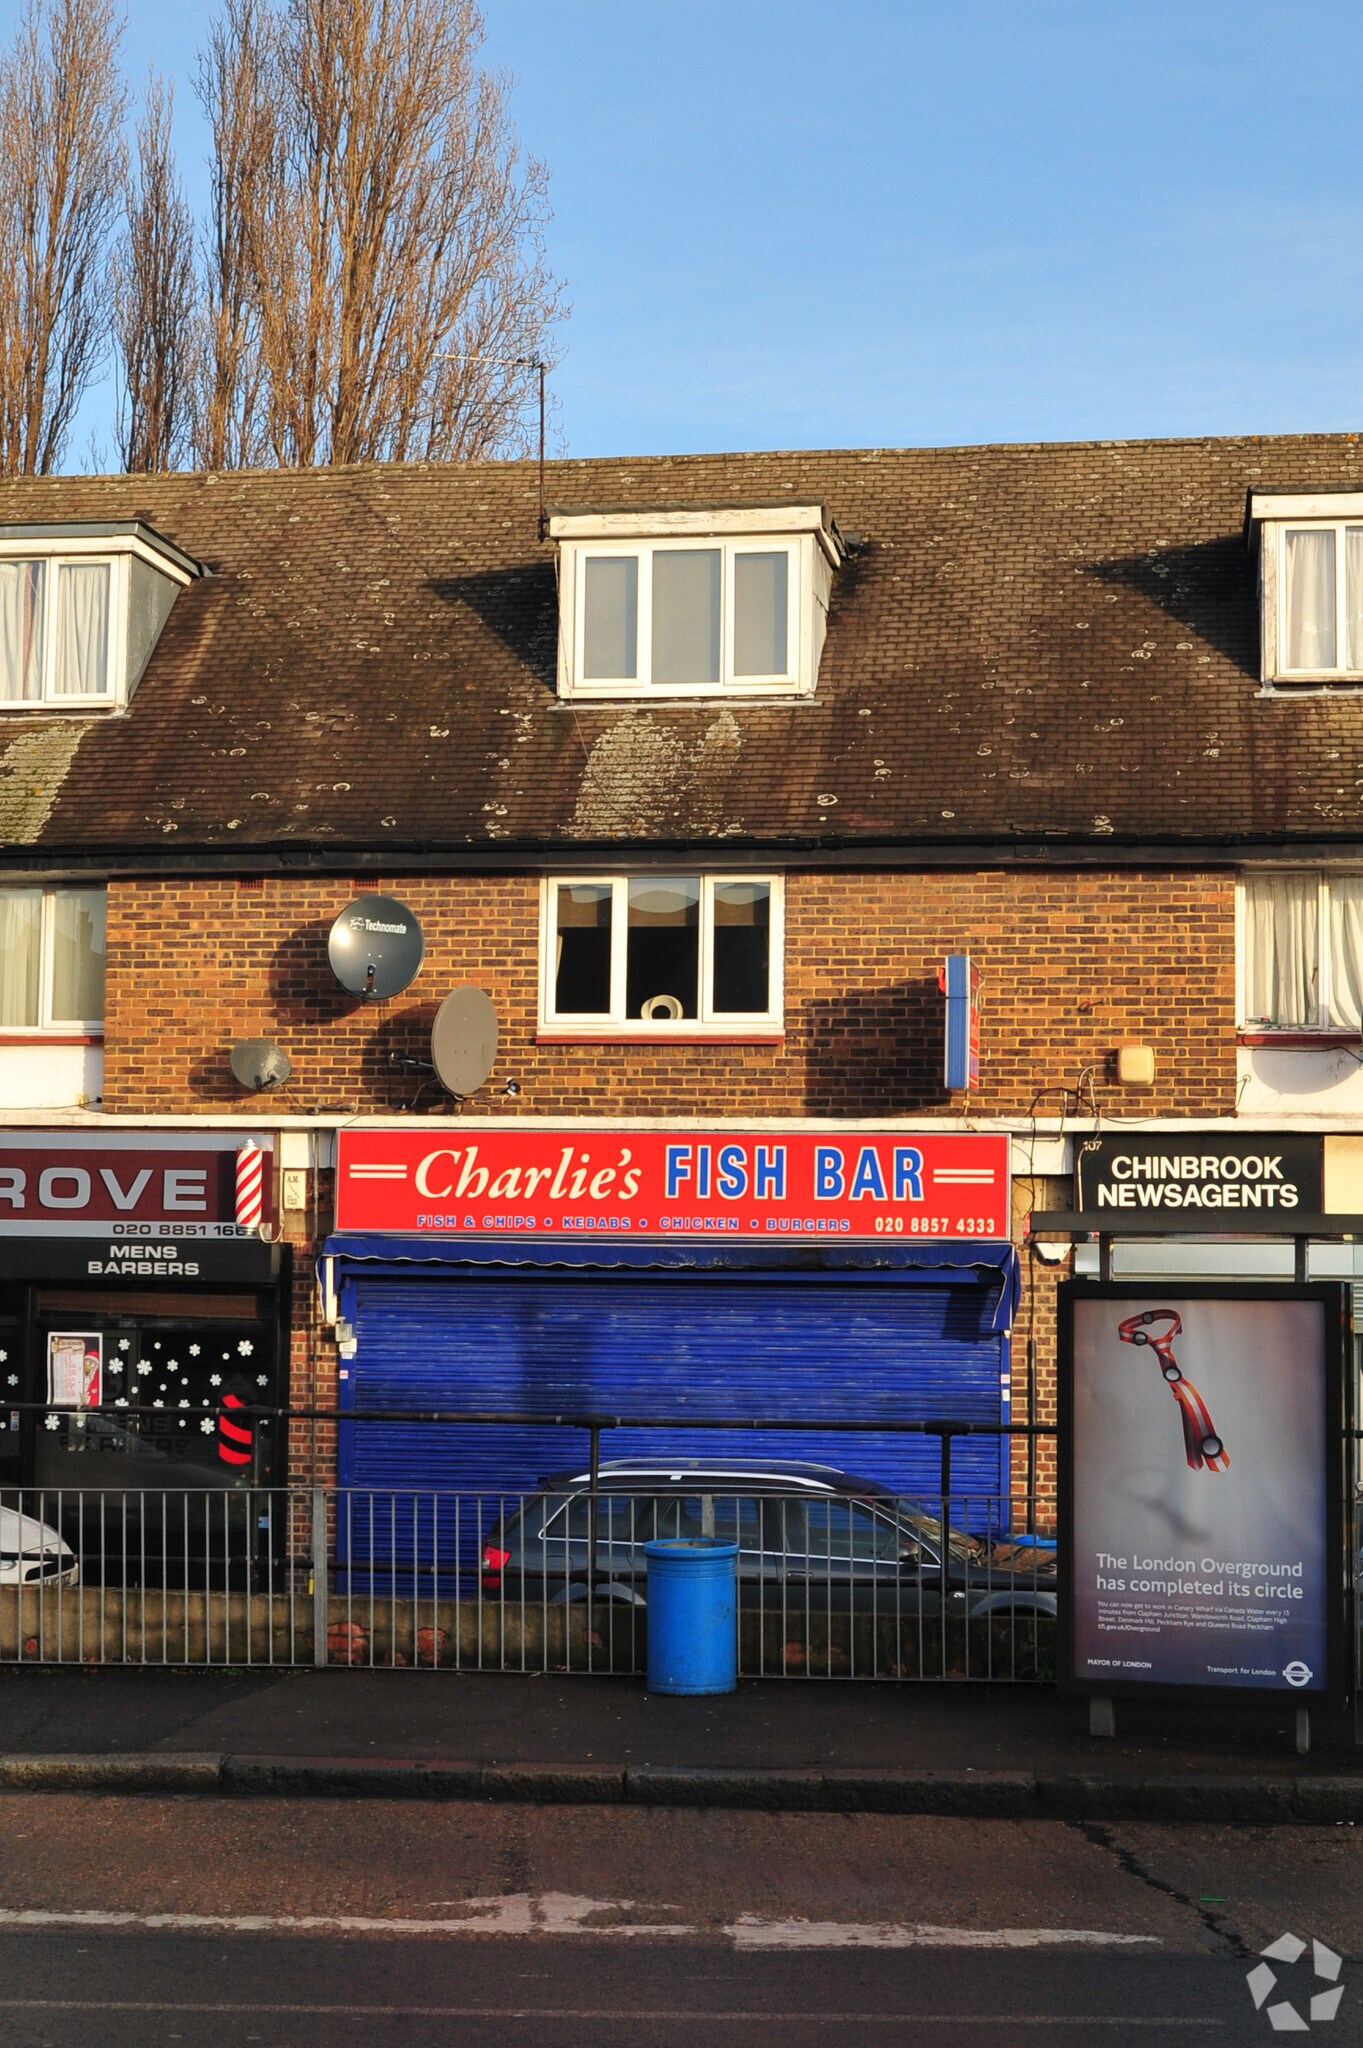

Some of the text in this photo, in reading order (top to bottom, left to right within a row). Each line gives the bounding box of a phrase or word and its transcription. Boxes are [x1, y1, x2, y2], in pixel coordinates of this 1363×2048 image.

[365, 919, 407, 934] Technomate
[1083, 1141, 1103, 1152] 107
[414, 1145, 924, 1201] Charlie's FISH BAR
[1111, 1156, 1284, 1180] CHINBROOK
[1098, 1184, 1299, 1208] NEWSAGENTS
[112, 1224, 151, 1235] 020
[159, 1225, 206, 1236] 8851
[416, 1215, 851, 1231] FISH & CHIPS KEBABS CHICKEN BURGERS
[875, 1217, 995, 1233] 020 8857 4333
[110, 1246, 178, 1260] MENS
[88, 1262, 199, 1275] BARBERS
[1096, 1553, 1303, 1578] The London Overground
[1096, 1575, 1303, 1599] has completed its circle
[1174, 1604, 1194, 1612] Canary
[1224, 1606, 1246, 1614] Canada
[1246, 1607, 1265, 1615] Water
[1122, 1660, 1152, 1669] LONDON
[1207, 1666, 1238, 1675] Transport
[1240, 1667, 1251, 1675] for
[1251, 1667, 1276, 1676] London
